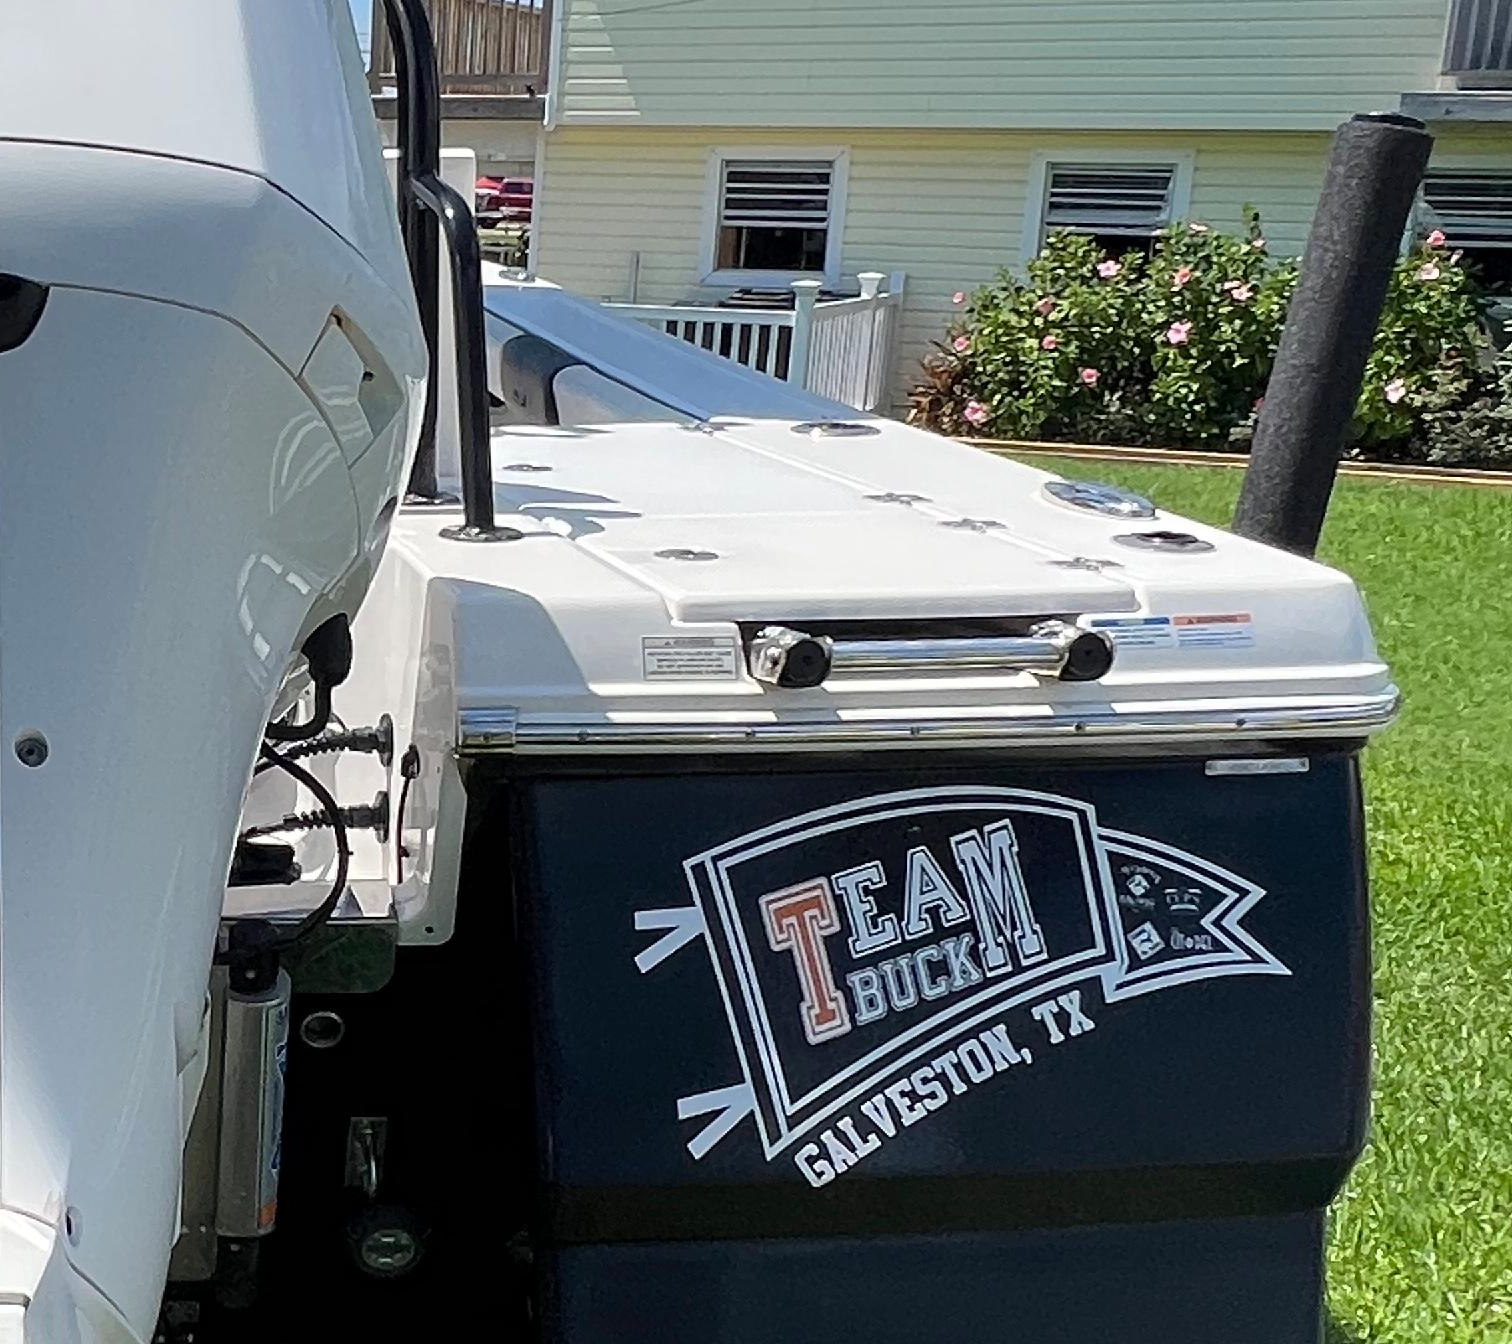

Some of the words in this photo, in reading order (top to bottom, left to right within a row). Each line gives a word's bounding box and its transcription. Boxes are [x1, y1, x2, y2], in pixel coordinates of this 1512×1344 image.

[759, 819, 1048, 1045] TEAM
[846, 932, 983, 1025] BUCK
[794, 1024, 1033, 1188] GALVESTON,
[1032, 989, 1095, 1044] TX
